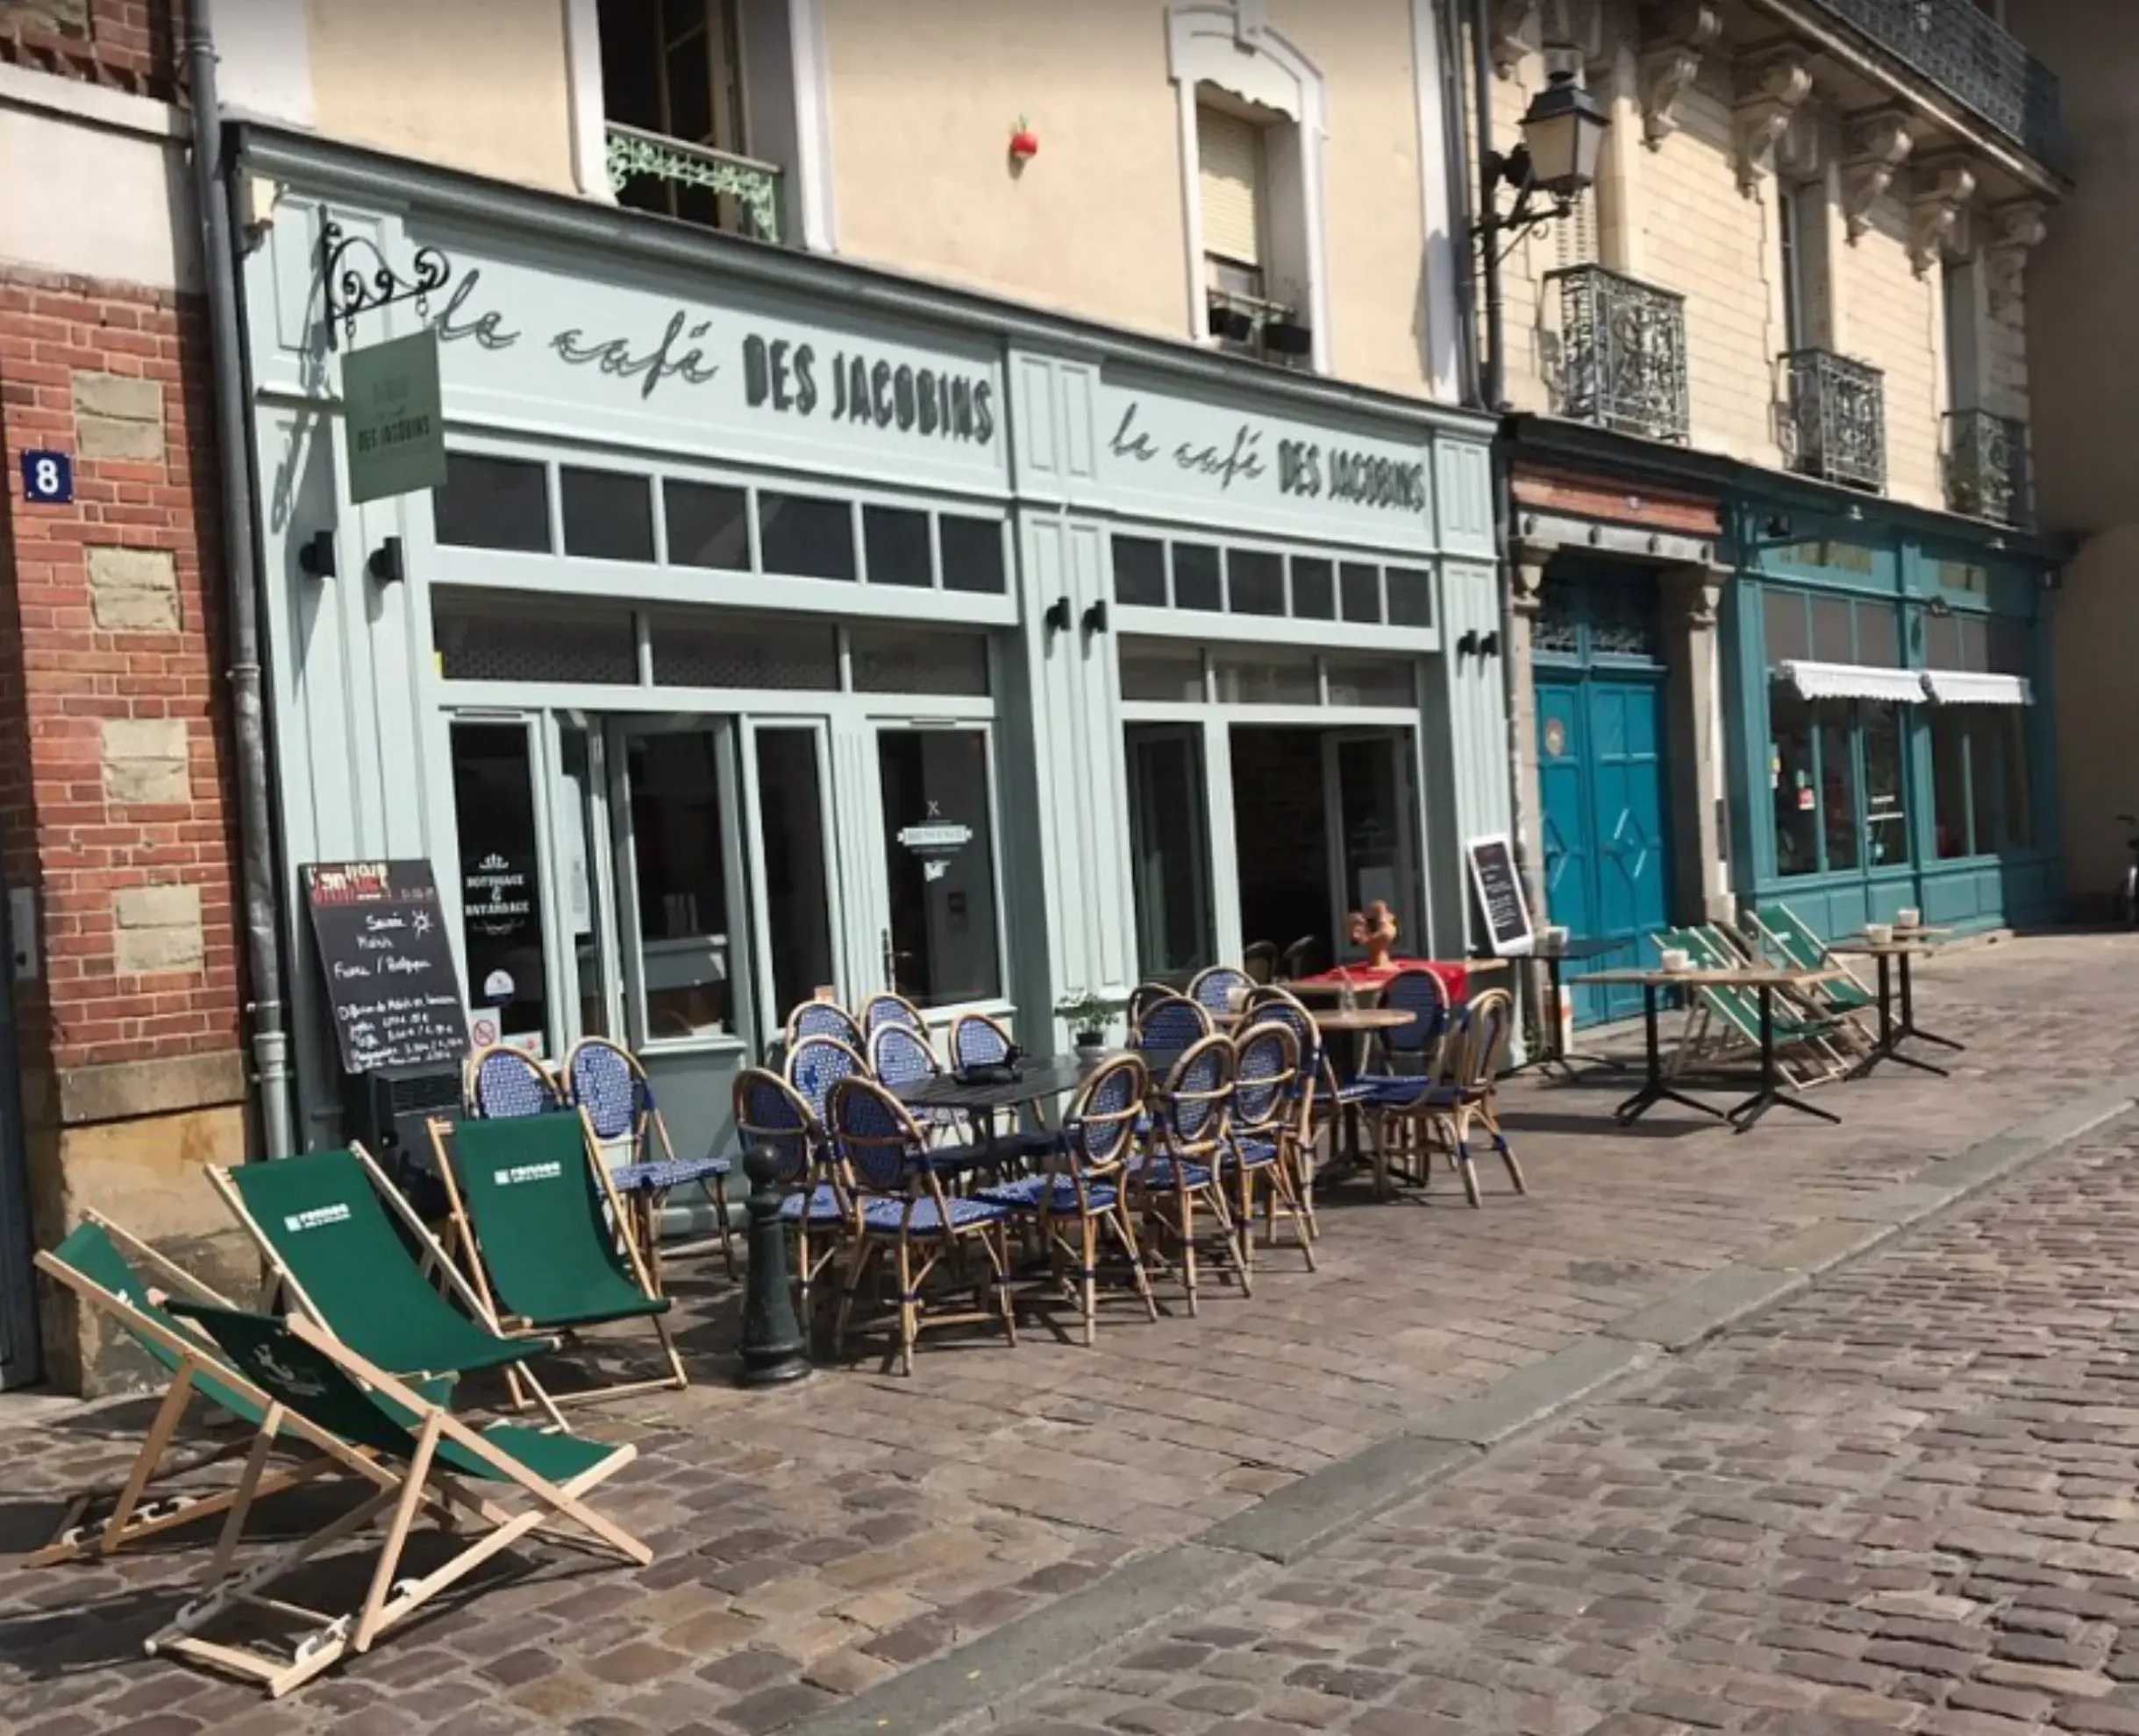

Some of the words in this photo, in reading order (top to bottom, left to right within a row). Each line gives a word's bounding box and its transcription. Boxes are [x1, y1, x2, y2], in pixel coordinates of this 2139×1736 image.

[434, 268, 522, 350] le
[549, 310, 720, 400] café
[743, 333, 817, 416] DES
[831, 351, 994, 445] JACOBINS
[36, 459, 59, 495] 8
[1108, 402, 1159, 461] le
[1173, 424, 1267, 491] café
[1278, 438, 1322, 498] DES
[1328, 447, 1426, 515] JACOBINS
